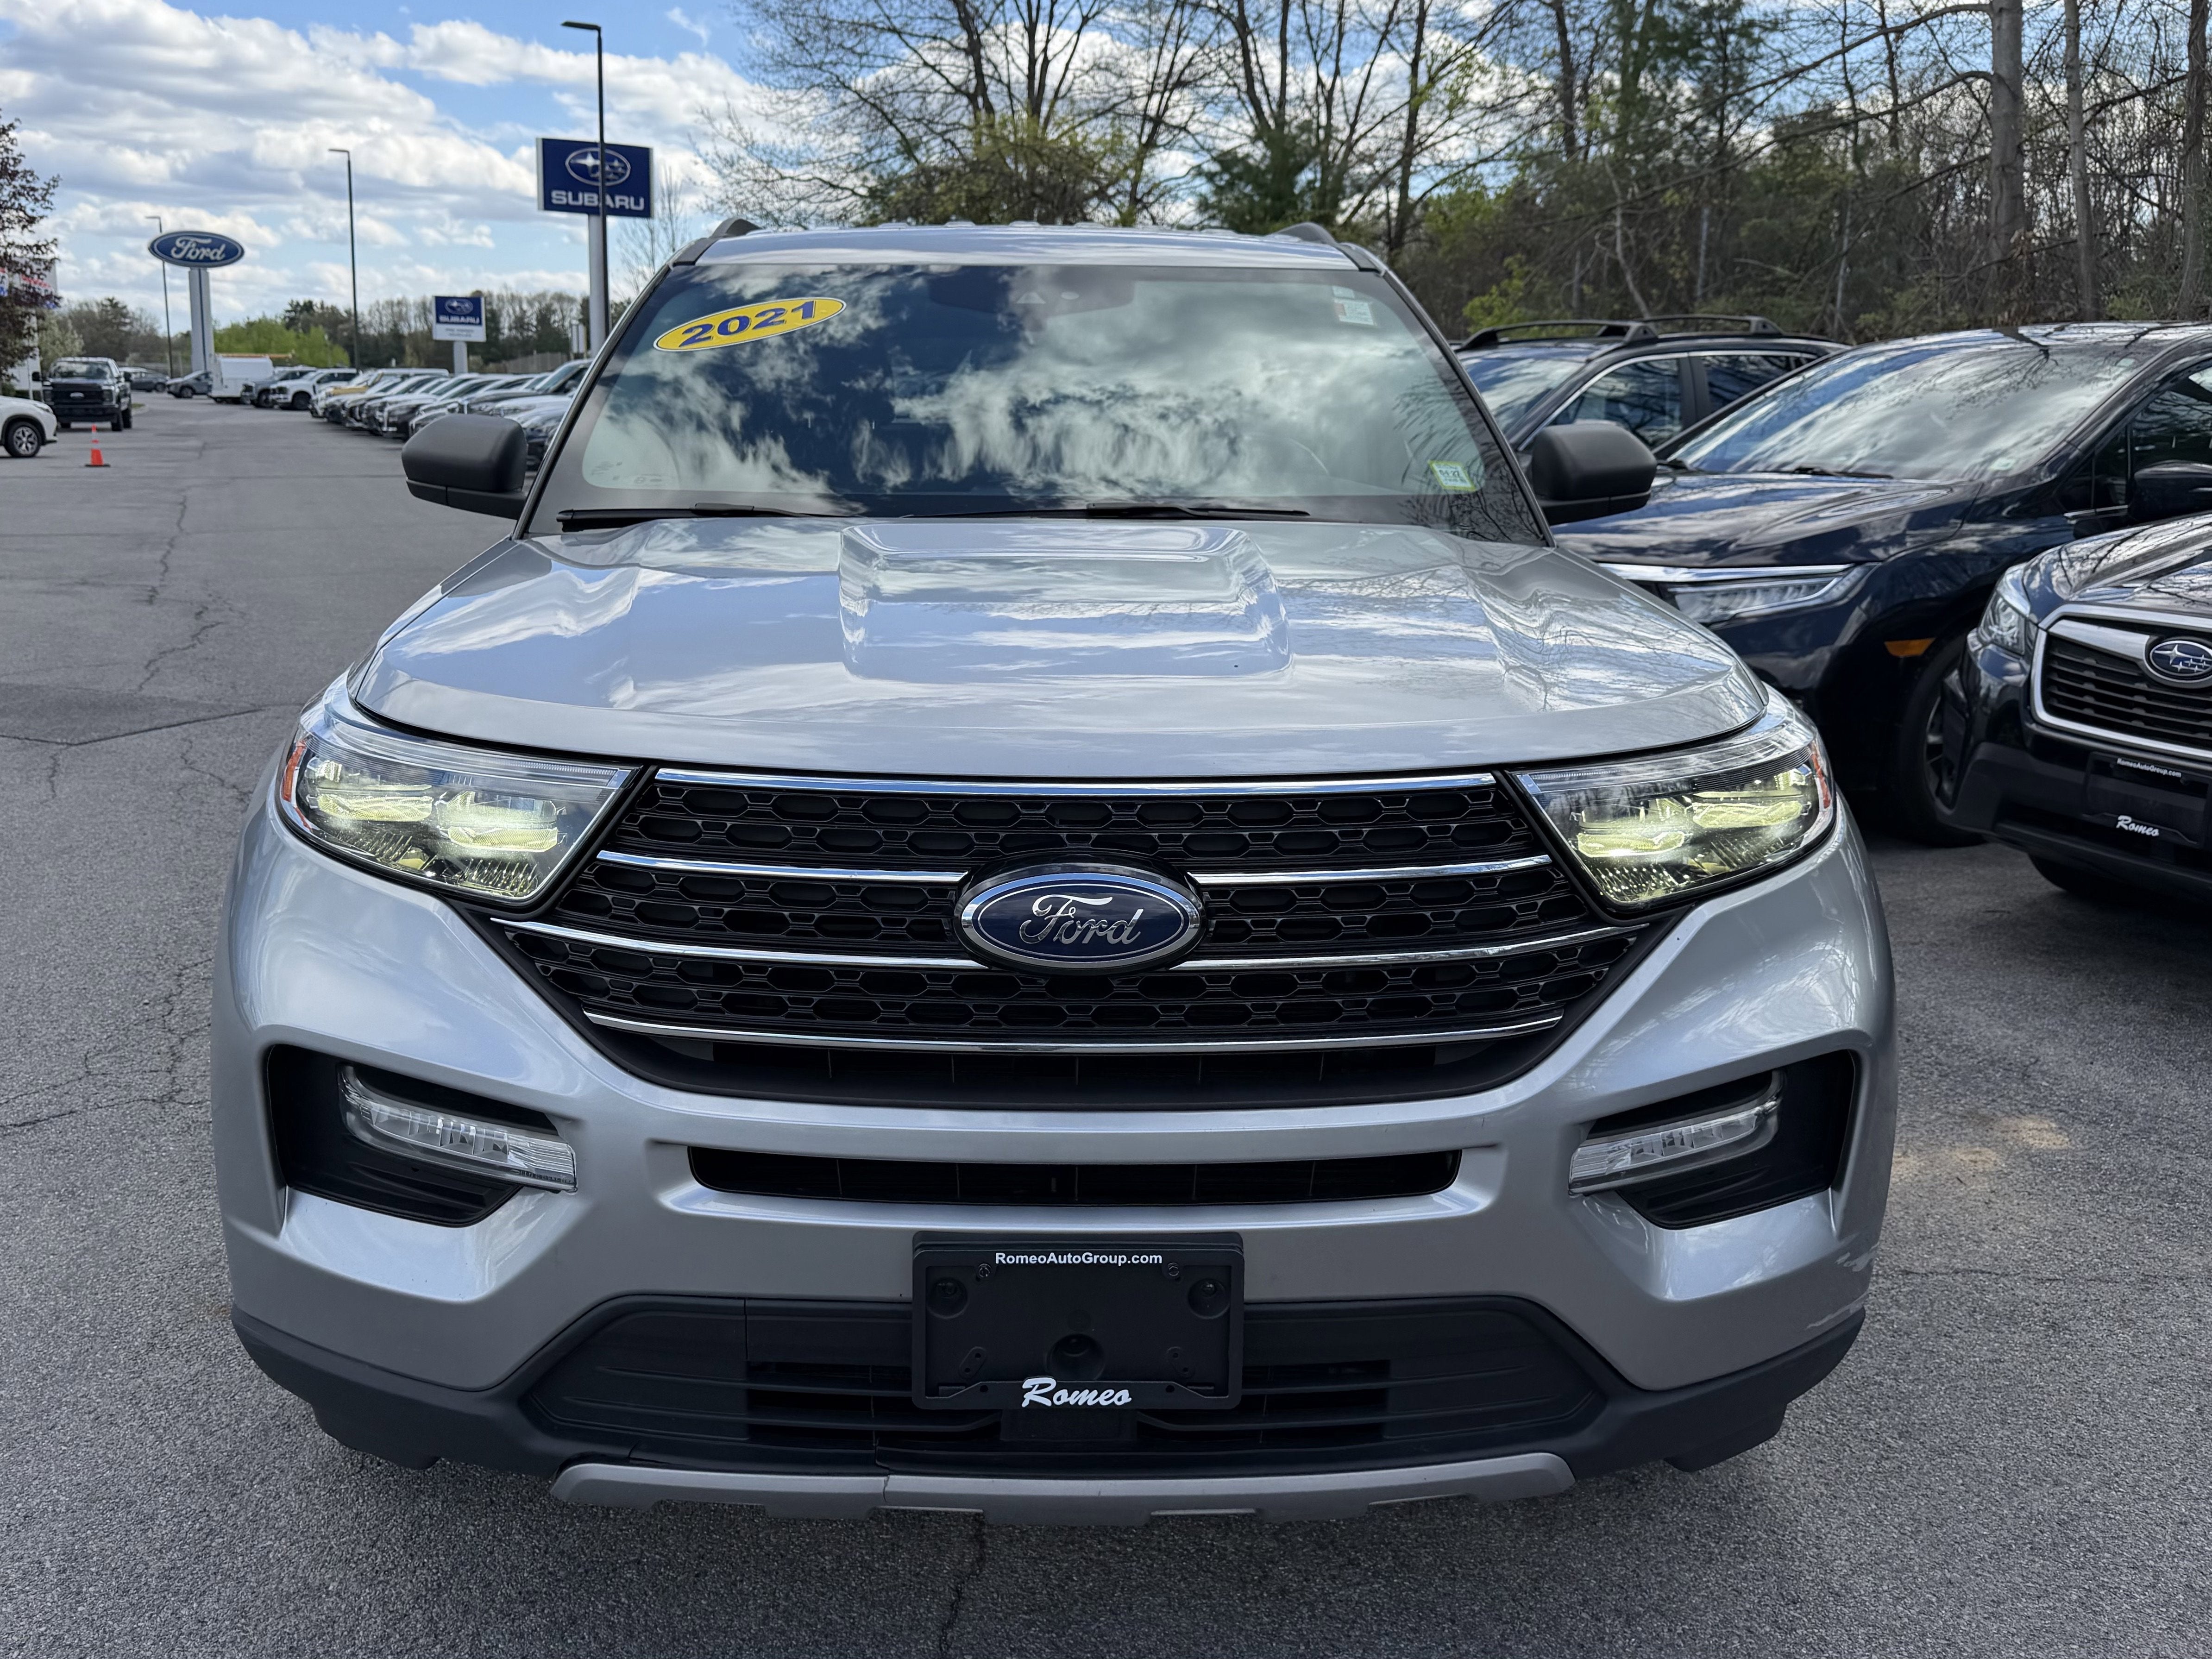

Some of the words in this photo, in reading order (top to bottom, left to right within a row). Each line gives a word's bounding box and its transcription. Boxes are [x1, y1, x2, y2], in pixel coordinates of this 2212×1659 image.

[171, 236, 226, 260] Ford
[679, 300, 816, 348] 2021
[2117, 757, 2181, 778] RomeoAutoGroup.com
[2116, 815, 2159, 836] Romeo
[1019, 894, 1144, 944] Ford
[995, 1252, 1163, 1266] RomeoAutoGroup.com
[1021, 1377, 1132, 1408] Romeo
